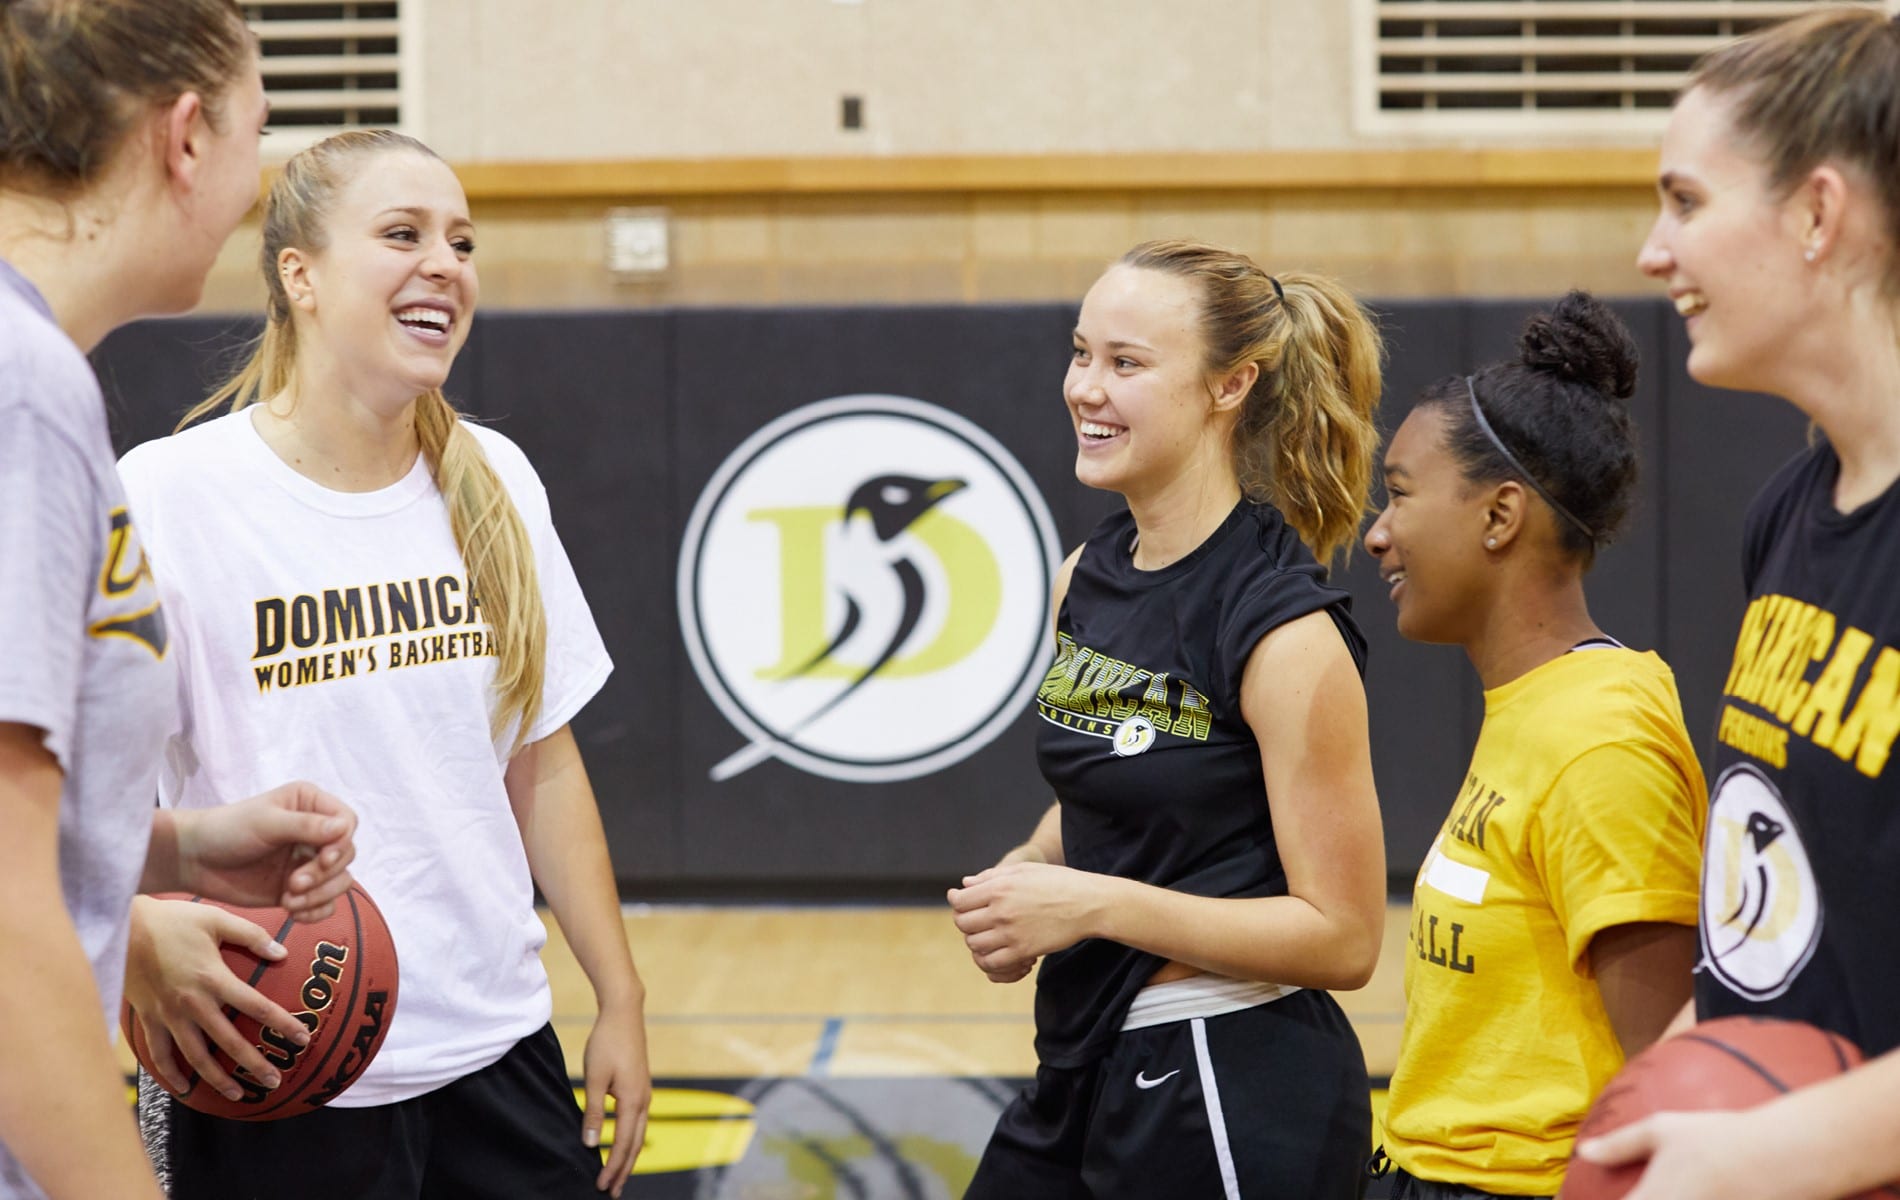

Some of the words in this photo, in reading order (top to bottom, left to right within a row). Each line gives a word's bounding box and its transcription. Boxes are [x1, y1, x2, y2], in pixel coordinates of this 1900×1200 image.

[252, 574, 481, 659] DOMINICA
[254, 646, 377, 694] WOMEN'S
[388, 630, 498, 669] BASKETBA
[303, 990, 388, 1107] NCAA
